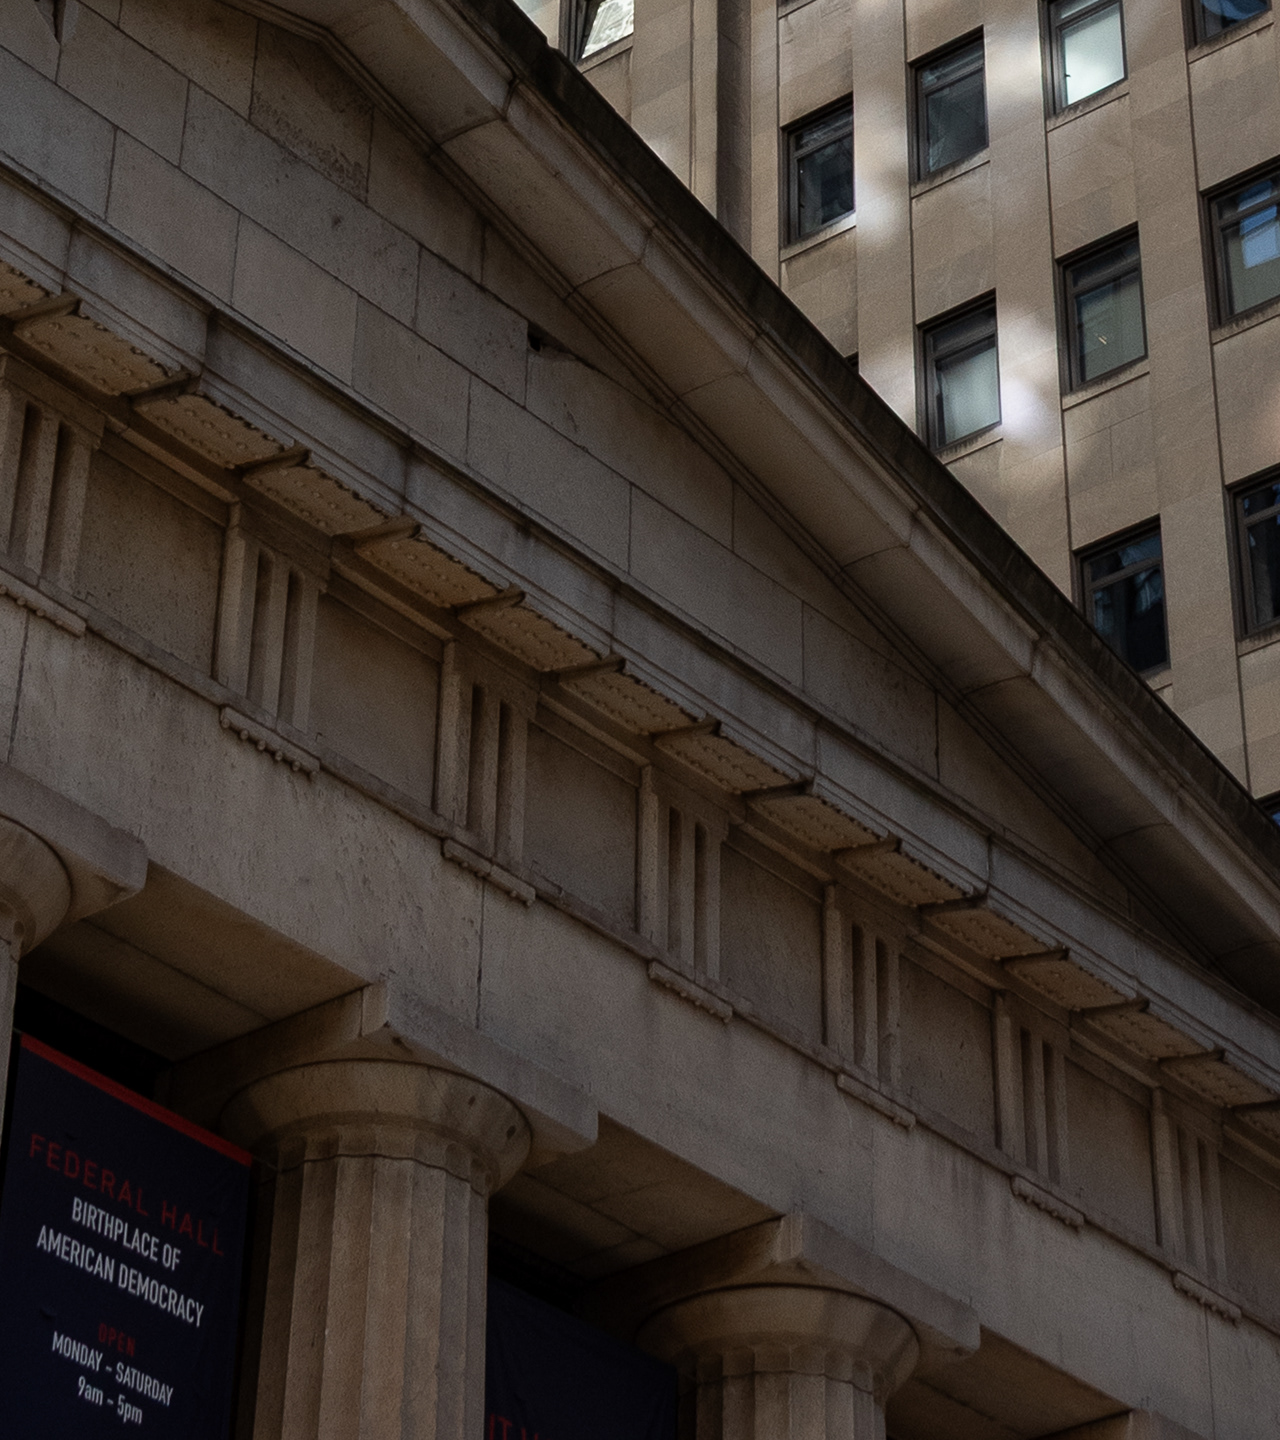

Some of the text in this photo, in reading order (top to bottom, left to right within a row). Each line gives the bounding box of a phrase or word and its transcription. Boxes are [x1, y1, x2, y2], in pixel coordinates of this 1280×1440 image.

[29, 1133, 224, 1256] FEDERAL HALL
[71, 1196, 182, 1271] BIRTHPLACE OF
[36, 1224, 205, 1328] AMERICAN DEMOCRACY
[51, 1330, 104, 1372] MONDAY
[115, 1361, 174, 1407] SATURDAY
[97, 1322, 136, 1357] OPEN
[77, 1375, 104, 1407] 9am
[117, 1393, 143, 1425] 5pm
